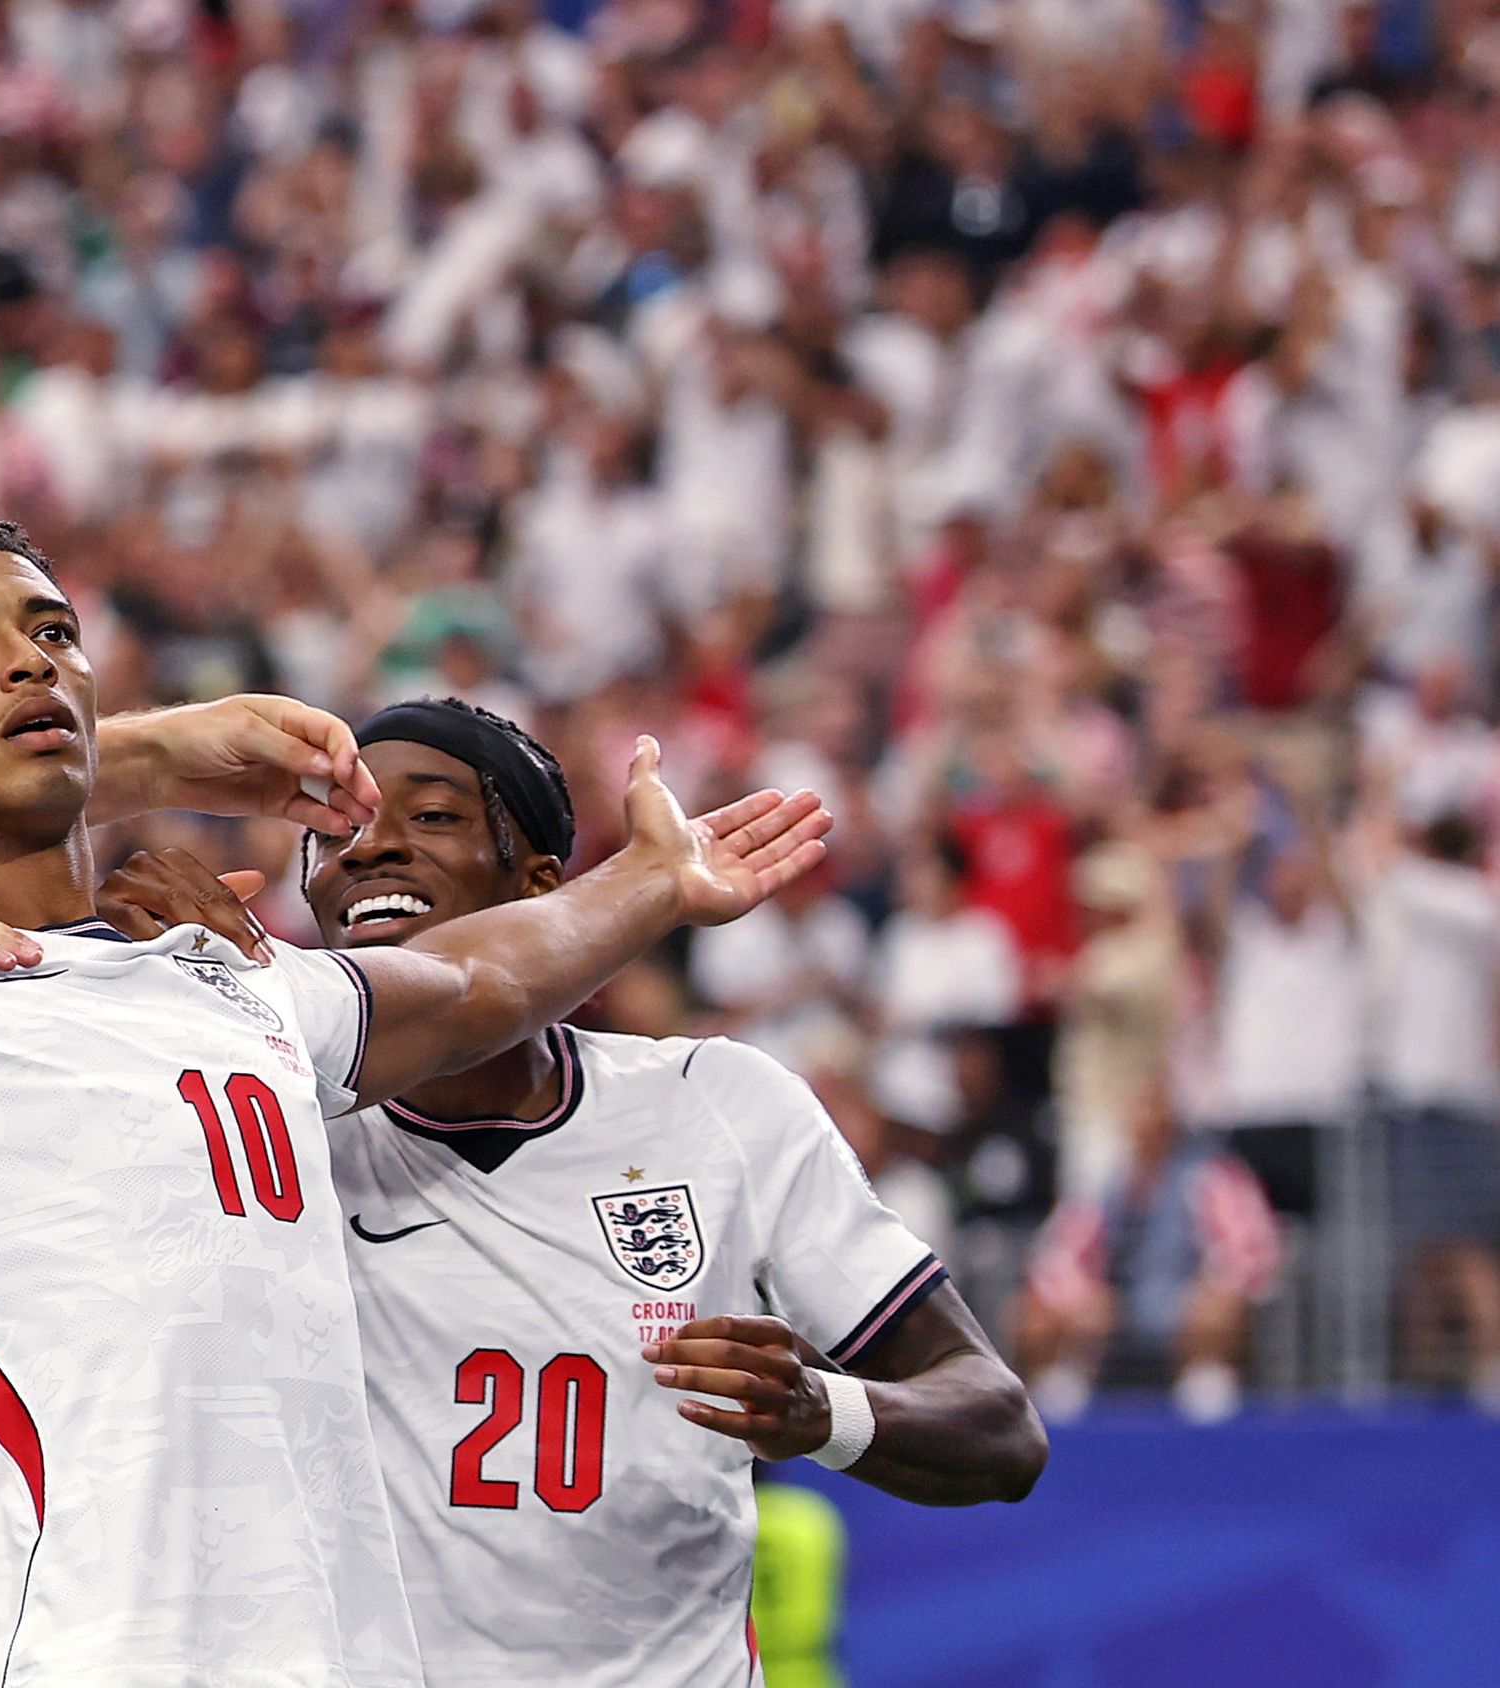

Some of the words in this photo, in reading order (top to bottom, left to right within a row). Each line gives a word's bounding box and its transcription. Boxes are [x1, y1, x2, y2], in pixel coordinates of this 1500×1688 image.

[176, 1069, 304, 1223] 10
[632, 1302, 696, 1321] CROATIA
[450, 1348, 608, 1513] 20
